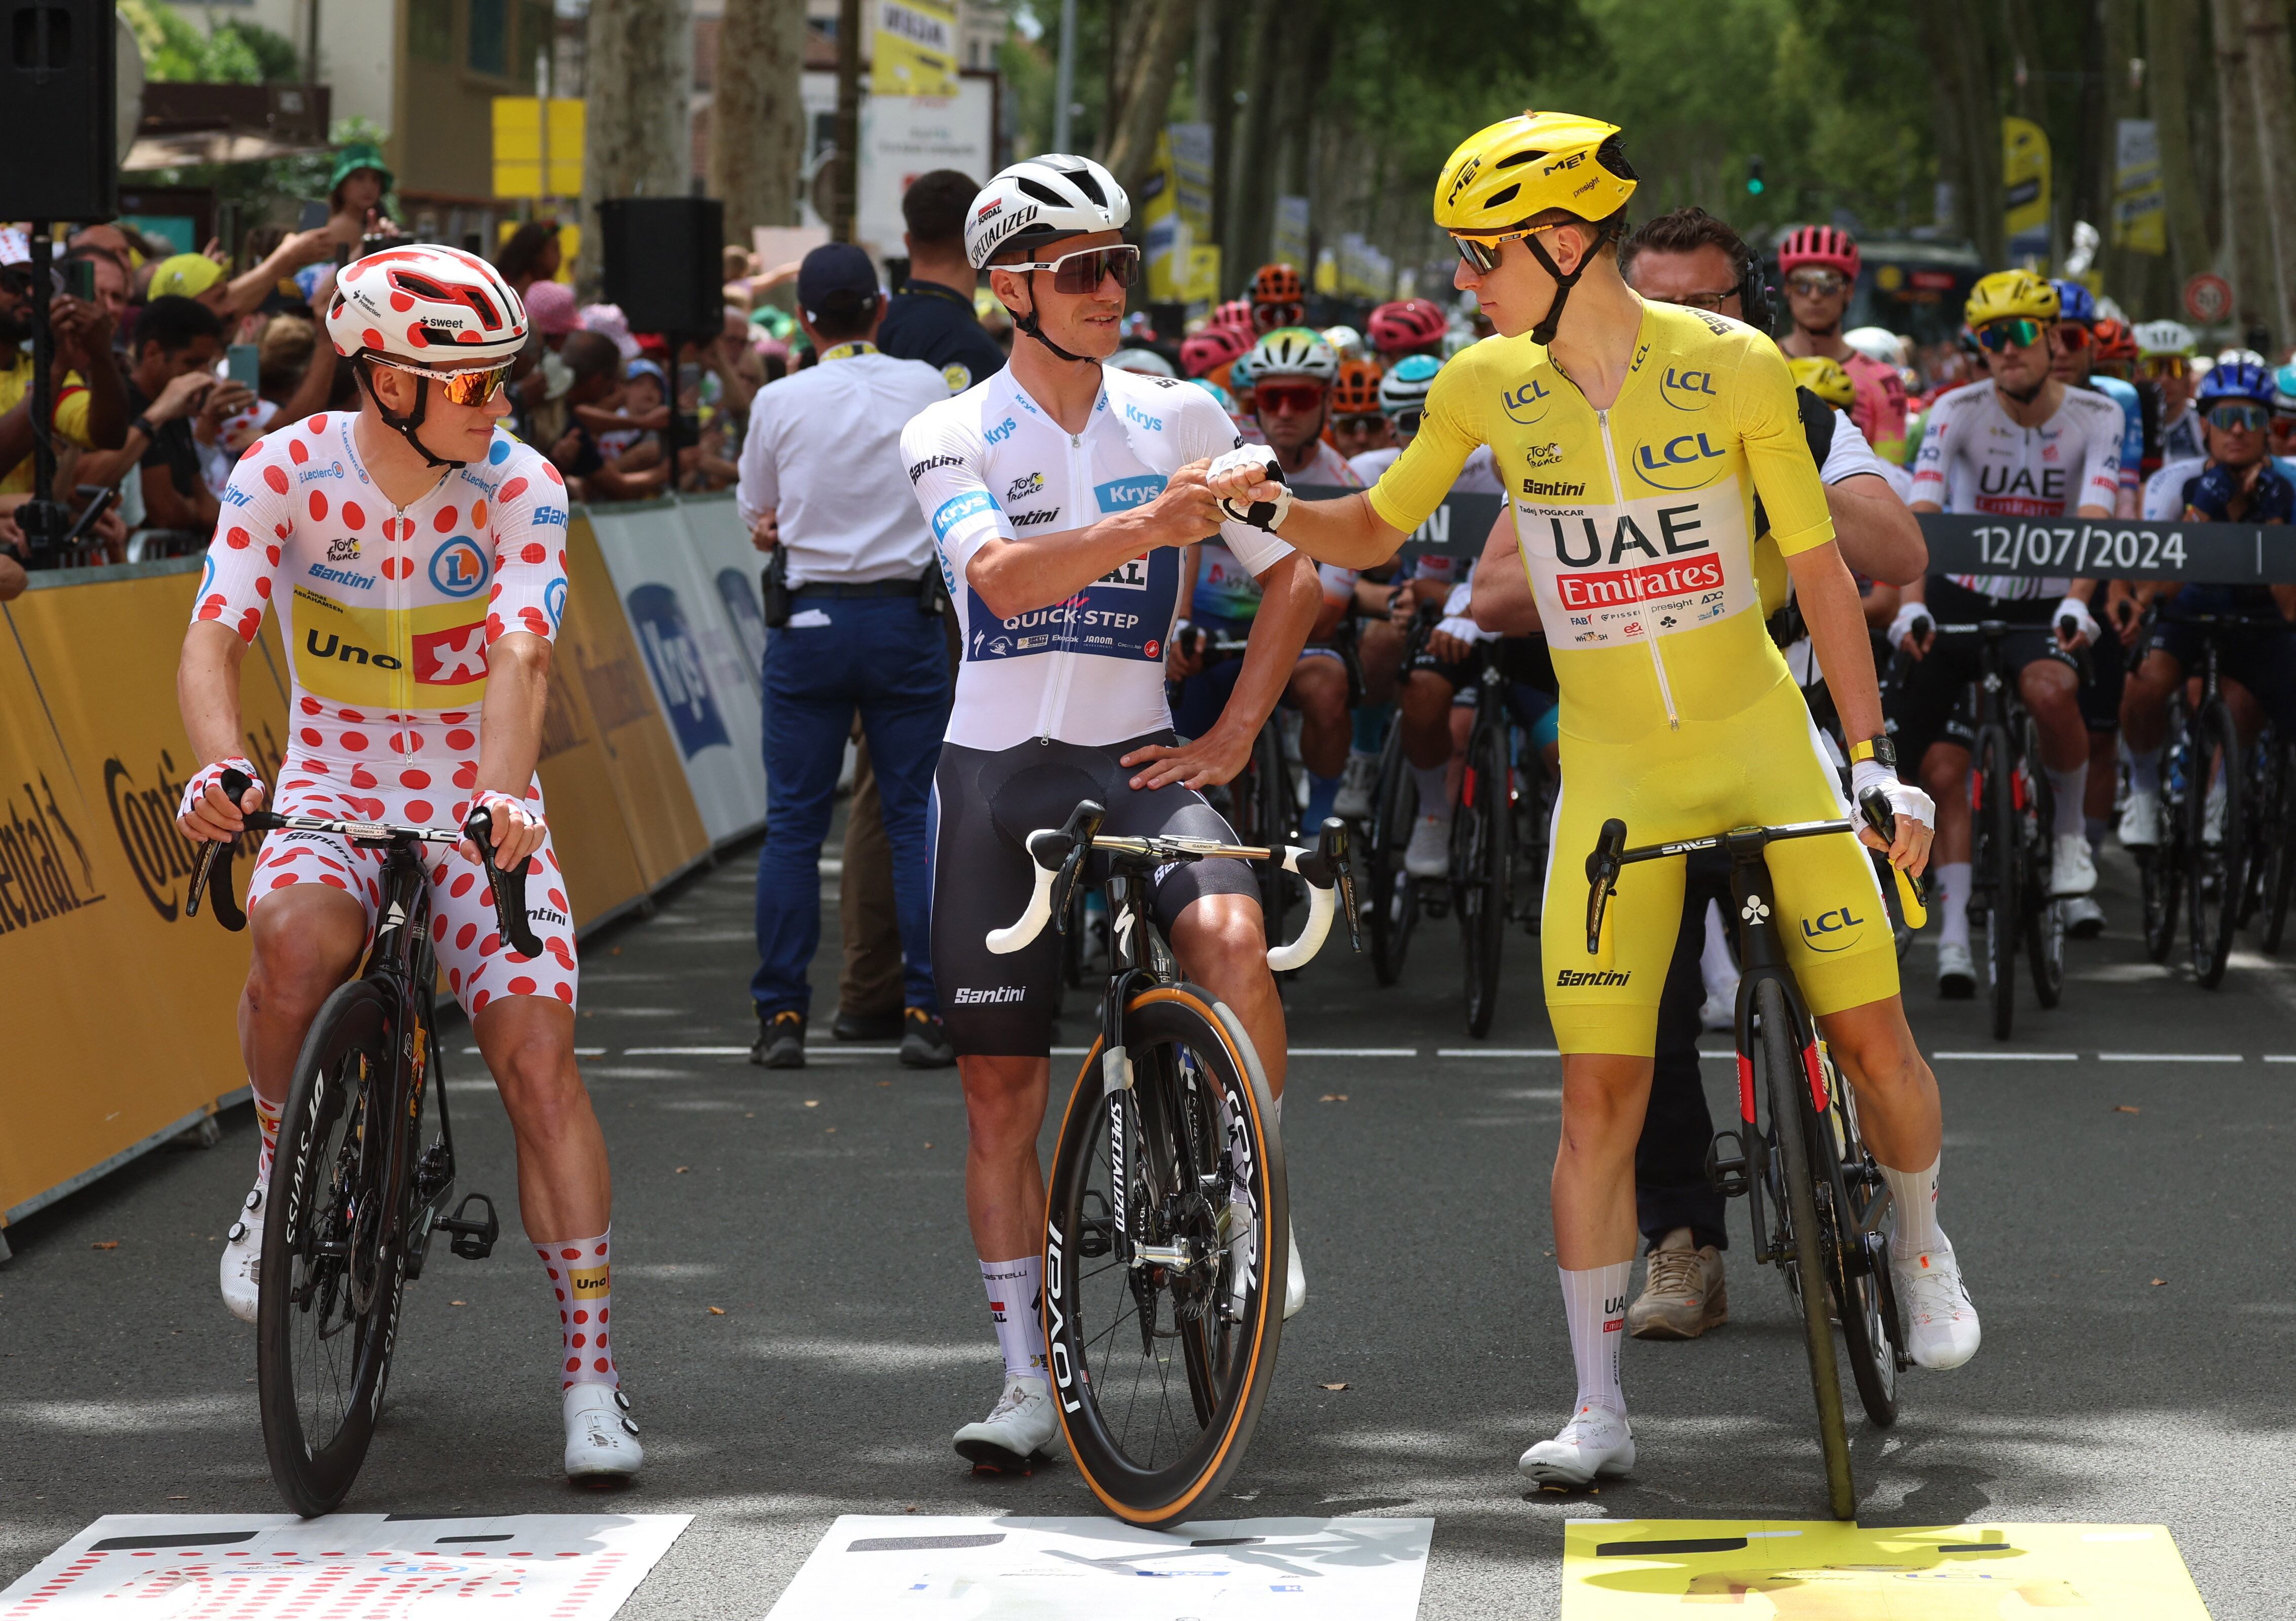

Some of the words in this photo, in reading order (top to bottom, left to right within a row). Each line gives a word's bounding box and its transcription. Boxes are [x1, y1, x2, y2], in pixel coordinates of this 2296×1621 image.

[1543, 150, 1588, 176] MET
[1448, 153, 1482, 207] MET
[1573, 176, 1600, 199] presight
[978, 206, 1002, 226] SOUDAL
[971, 204, 1038, 266] SPECIALIZED
[358, 299, 381, 318] Protection
[362, 294, 375, 307] Sweet
[430, 318, 463, 329] sweet
[1631, 343, 1650, 372] LCL
[1666, 368, 1717, 396] LCL
[1016, 394, 1037, 414] Krys
[1096, 390, 1109, 412] Krys
[1503, 380, 1550, 410] LCL
[1126, 403, 1162, 431] Krys
[984, 417, 1017, 446] Krys
[1527, 442, 1559, 458] TOUR
[1640, 432, 1726, 470] LCL
[299, 468, 333, 484] E.Leclerc
[460, 470, 490, 492] E.Leclerc
[909, 455, 964, 487] Santini
[1011, 472, 1041, 491] TOUR
[1980, 464, 2066, 498] UAE
[1110, 485, 1159, 505] Krys
[1523, 478, 1586, 496] Santini
[531, 506, 568, 531] San
[936, 495, 988, 529] Krys
[1009, 507, 1060, 528] ntini
[1520, 505, 1537, 516] Tadej
[1539, 509, 1584, 517] POGACAR
[331, 537, 359, 552] TOUR
[1550, 503, 1709, 568] UAE
[1973, 522, 2187, 573] 12/07/2024
[308, 563, 377, 590] Santini
[1097, 563, 1145, 586] AL
[1560, 561, 1720, 607] Emirates
[294, 589, 343, 614] ABRAHAMSEN
[307, 590, 327, 601] Jonas
[1651, 599, 1693, 613] presight
[1611, 610, 1641, 620] PISSEI
[1052, 634, 1079, 643] Ekopak
[1083, 635, 1113, 645] JANOM
[306, 629, 402, 671] Uno
[282, 832, 356, 864] Santini
[1803, 907, 1864, 938] LCL
[1557, 969, 1631, 987] Santini
[954, 985, 1027, 1004] Santini
[1110, 1102, 1126, 1233] SPECIALIZED
[576, 1278, 606, 1290] Uno
[1605, 1295, 1627, 1315] UA
[1605, 1321, 1624, 1331] Emira
